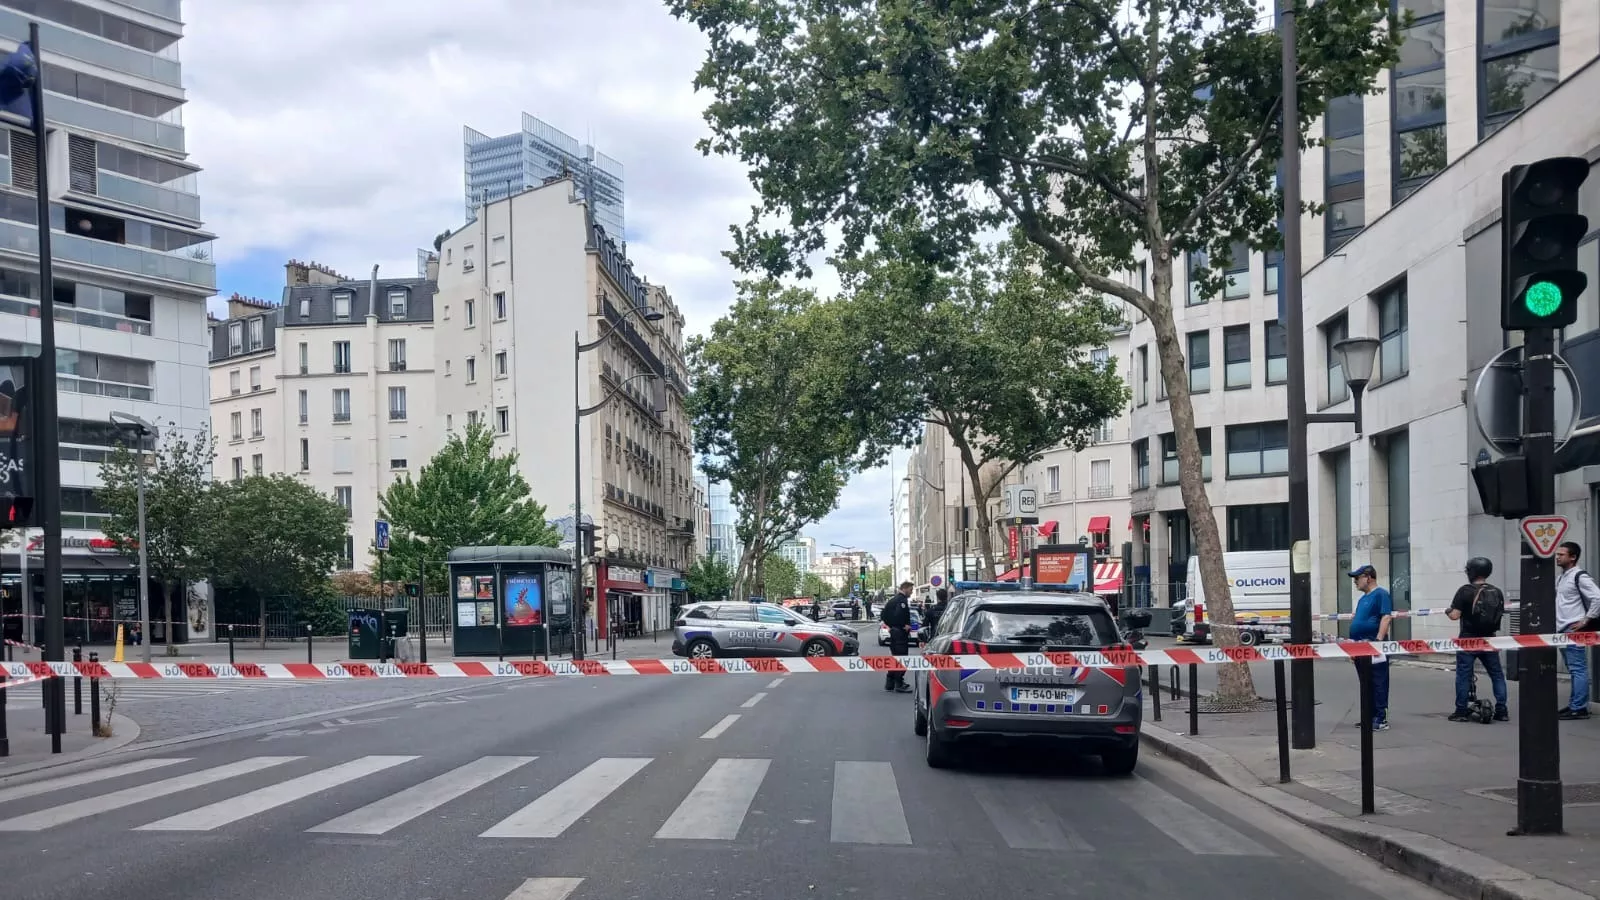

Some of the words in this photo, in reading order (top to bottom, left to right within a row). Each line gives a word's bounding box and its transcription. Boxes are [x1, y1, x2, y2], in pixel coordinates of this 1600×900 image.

[1021, 496, 1035, 506] RER
[1235, 577, 1286, 587] OLICHON
[728, 631, 771, 639] POLICE
